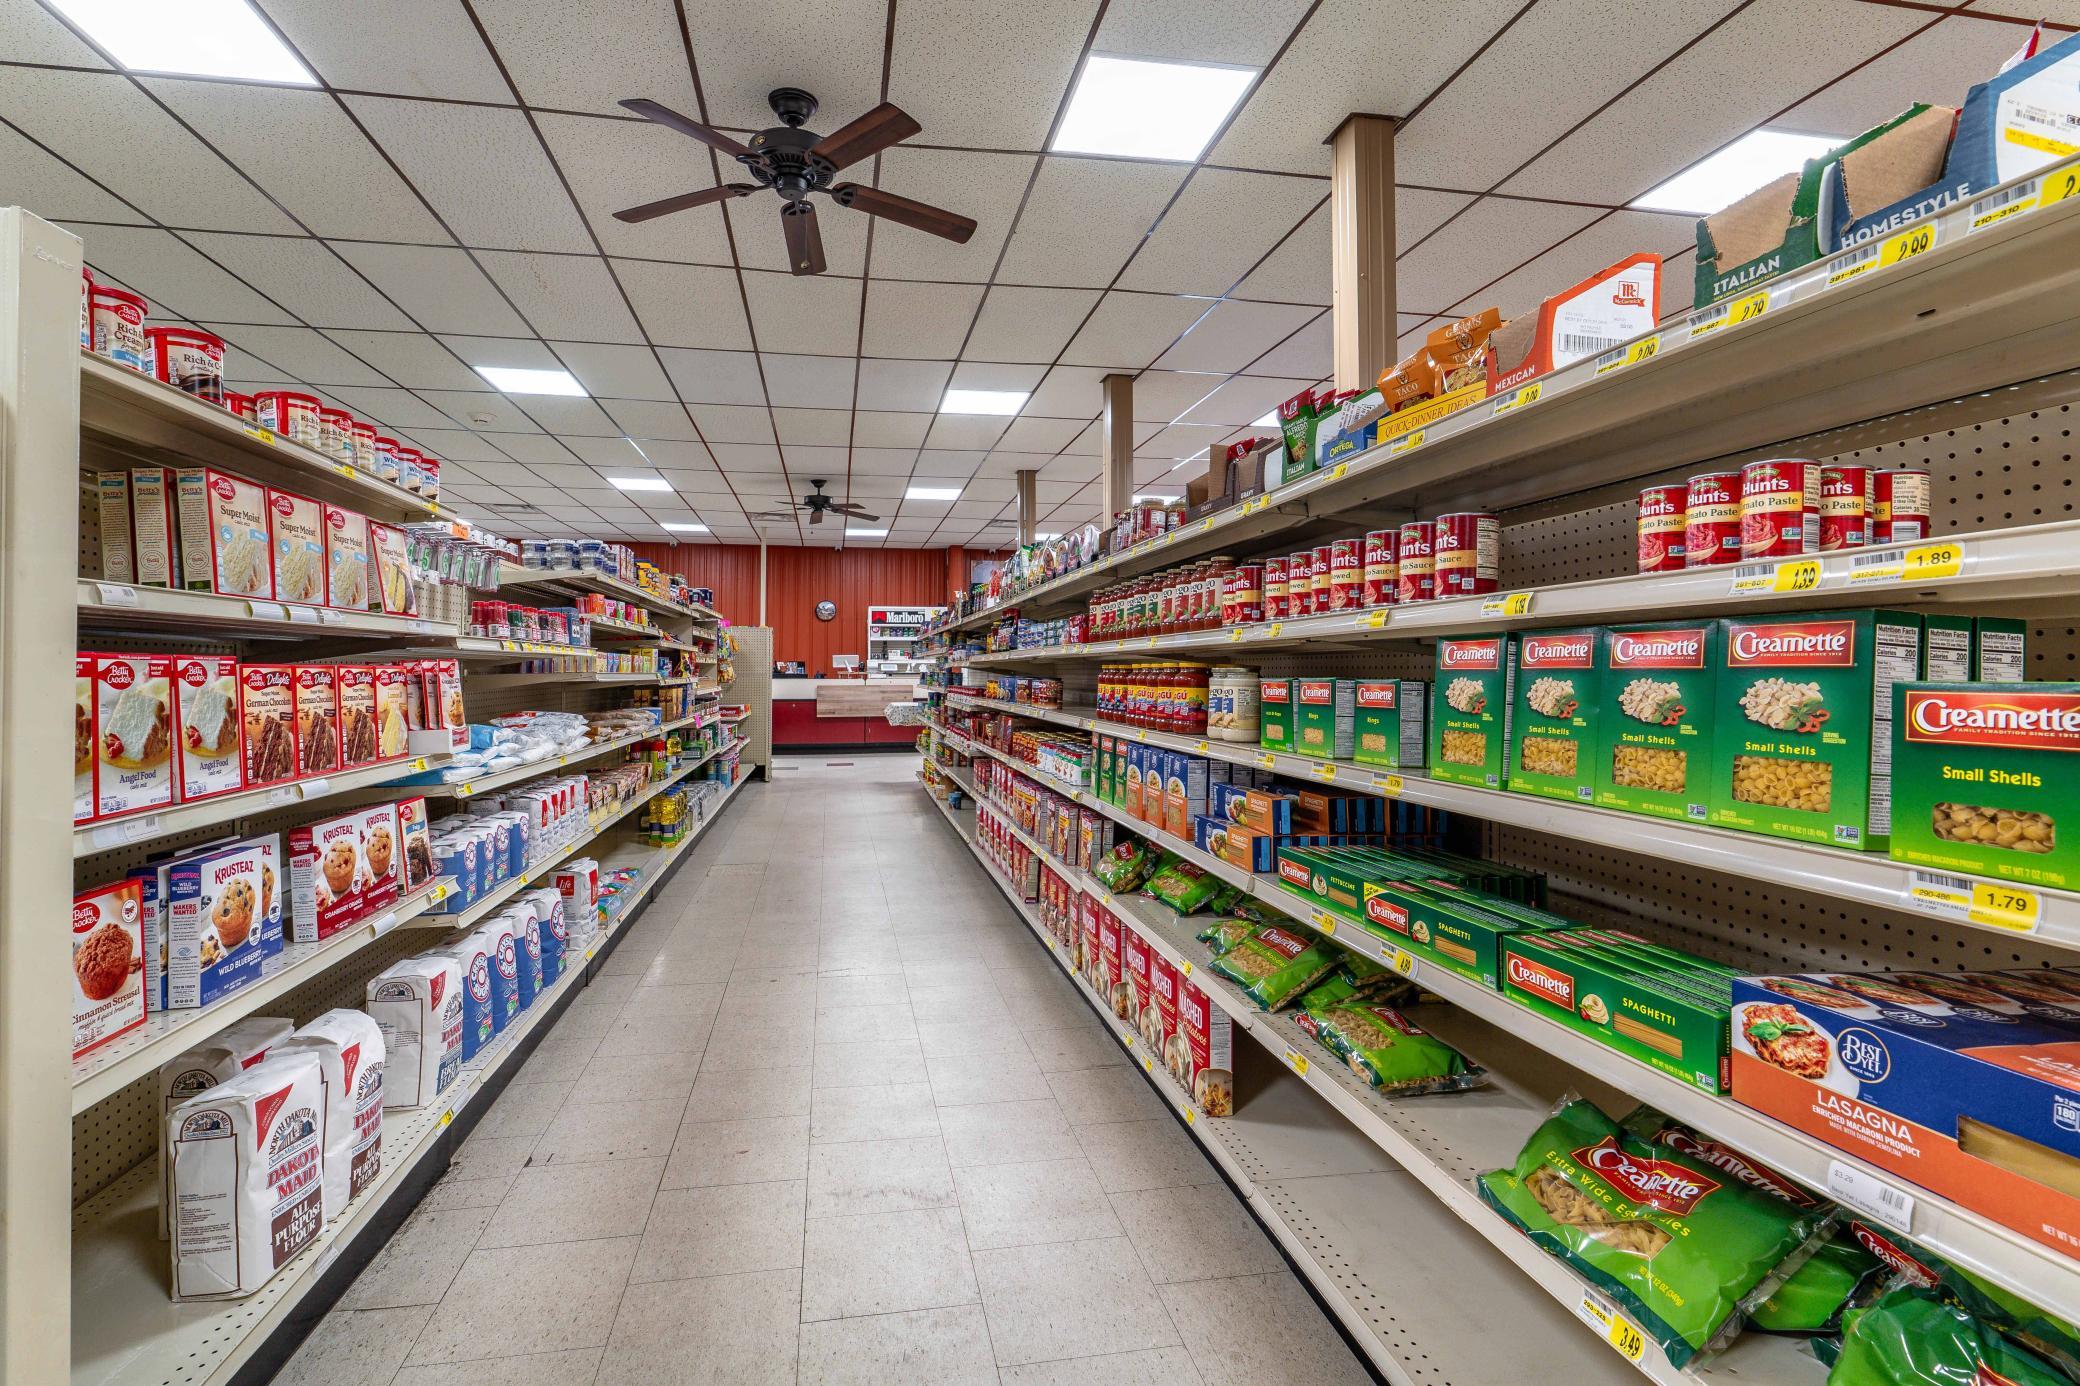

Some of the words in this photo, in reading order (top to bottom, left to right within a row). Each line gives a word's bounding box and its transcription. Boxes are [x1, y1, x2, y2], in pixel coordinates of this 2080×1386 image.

[1840, 182, 1971, 250] HOMESTYLE
[1973, 205, 2020, 227] 210-310
[1897, 232, 1929, 262] 2.99
[1713, 255, 1781, 297] ITALIAN
[1613, 298, 1642, 306] McCormick
[1740, 299, 1765, 322] 2.79
[117, 322, 138, 336] Rich
[183, 353, 206, 366] Rich
[1495, 365, 1536, 392] MEXICAN
[1395, 383, 1419, 396] TACO
[300, 415, 315, 426] Rich
[320, 428, 337, 438] Rich
[1329, 441, 1354, 457] ORTEGA
[1286, 462, 1305, 476] ITALIAN
[1742, 479, 1789, 494] Hunt's
[1687, 490, 1729, 506] Hunt's
[1768, 496, 1798, 506] Paste
[1831, 501, 1861, 510] Paste
[220, 505, 242, 520] Super
[242, 511, 261, 524] Moist
[1640, 502, 1675, 517] Hunt's
[1710, 508, 1738, 517] Paste
[280, 520, 299, 534] Super
[299, 526, 316, 537] Moist
[1657, 519, 1683, 528] Paste
[333, 533, 350, 545] Super
[350, 537, 363, 548] Moist
[421, 548, 431, 571] 5
[442, 551, 450, 574] 6
[455, 555, 464, 577] 7
[1409, 561, 1434, 570] Sauce
[1438, 554, 1462, 563] Sauce
[1916, 551, 1952, 567] 1.89
[1372, 567, 1395, 576] Sauce
[886, 611, 924, 624] Marlboro
[1878, 626, 1901, 634] Nutrition
[1930, 630, 1953, 638] Nutrition
[1983, 633, 2007, 641] Nutrition
[1526, 641, 1589, 663] Creamette
[1615, 637, 1699, 664] Creamette
[1734, 631, 1847, 658] Creamette
[1445, 645, 1496, 664] Creamette
[1905, 650, 1917, 658] 200
[1956, 653, 1968, 661] 200
[2010, 655, 2022, 663] 200
[107, 674, 133, 684] Crocker
[110, 665, 129, 677] Betty
[186, 674, 206, 684] Crocker
[187, 666, 203, 677] Betty
[250, 672, 264, 681] Betty
[266, 671, 291, 686] Delights
[315, 671, 332, 686] Delights
[356, 671, 373, 685] Delights
[248, 679, 266, 688] Crocker
[1261, 684, 1287, 699] Creamette
[342, 694, 357, 703] German
[357, 693, 374, 702] Chocolate
[1301, 684, 1329, 700] Creamette
[1358, 687, 1393, 703] Creamette
[246, 699, 269, 708] German
[269, 697, 292, 707] Chocolate
[298, 697, 315, 706] German
[315, 695, 334, 705] Chocolate
[1308, 712, 1319, 720] Rings
[1367, 716, 1380, 725] Rings
[1914, 698, 2080, 734] Creamette
[1447, 720, 1461, 729] Small
[1462, 721, 1480, 730] Shells
[1528, 725, 1547, 735] Small
[1547, 726, 1570, 737] Shells
[1983, 729, 2027, 737] TRADITION
[1622, 733, 1645, 743] Small
[1647, 734, 1676, 746] Shells
[1745, 741, 1774, 753] Small
[1779, 743, 1817, 757] Shells
[199, 761, 215, 771] Angel
[215, 758, 229, 768] Food
[119, 773, 139, 784] Angel
[139, 769, 157, 780] Food
[1942, 765, 1984, 782] Small
[1989, 768, 2042, 788] Shells
[366, 812, 391, 829] KRUSTEAZ
[323, 824, 354, 844] KRUSTEAZ
[215, 860, 255, 885] KRUSTEAZ
[1279, 860, 1309, 885] Creamette
[1998, 864, 2012, 874] NET
[2013, 867, 2025, 877] WT
[2025, 868, 2031, 878] 7
[2031, 870, 2042, 881] OZ
[1330, 875, 1356, 891] FETTUCCINE
[368, 886, 385, 899] CRANBERRY
[324, 904, 348, 920] CRANBERRY
[348, 897, 364, 909] ORANGE
[1987, 893, 2027, 912] 1.79
[73, 908, 93, 922] Betty
[1367, 899, 1406, 926] Creamette
[1101, 925, 1117, 953] MASHED
[1438, 922, 1471, 941] SPAGHETTI
[218, 961, 235, 976] WILD
[235, 949, 262, 969] BLUEBERRY
[1126, 942, 1146, 975] MASHED
[1130, 965, 1149, 988] Potatoes
[1151, 965, 1172, 1000] MASHED
[1509, 958, 1571, 998] Creamette
[112, 986, 141, 1005] Streusel
[1155, 992, 1176, 1014] Potatoes
[1179, 990, 1203, 1030] MASHED
[1622, 997, 1677, 1027] SPAGHETTI
[1182, 1017, 1208, 1046] Potatoes
[1841, 1034, 1882, 1065] BEST
[1723, 1057, 1731, 1088] Creamette
[1861, 1057, 1881, 1074] YET
[356, 1072, 368, 1101] NORTH
[1817, 1089, 1914, 1144] LASAGNA
[2056, 1106, 2077, 1120] 180
[269, 1121, 285, 1154] NORTH
[285, 1107, 311, 1129] DAKOTA
[1812, 1105, 1845, 1125] ENRICHED
[1846, 1118, 1884, 1142] MACARONI
[1885, 1134, 1921, 1158] PRODUCT
[1829, 1121, 1843, 1132] MADE
[1843, 1126, 1856, 1137] WITH
[1856, 1131, 1876, 1146] DURUM
[1876, 1139, 1903, 1158] SEMOLINA
[266, 1145, 320, 1190] DAKOTA
[277, 1164, 317, 1202] MAID
[1545, 1150, 1576, 1177] Extra
[1579, 1173, 1613, 1204] Wide
[1834, 1168, 1854, 1184] $3.29
[290, 1200, 310, 1222] ALL
[274, 1203, 322, 1247] PURPOSE
[284, 1220, 316, 1252] FLOUR
[2042, 1223, 2056, 1237] NET
[2056, 1229, 2068, 1242] WT
[2069, 1234, 2079, 1247] 16
[1584, 1299, 1606, 1321] 293-225
[1620, 1326, 1641, 1357] 3.49
